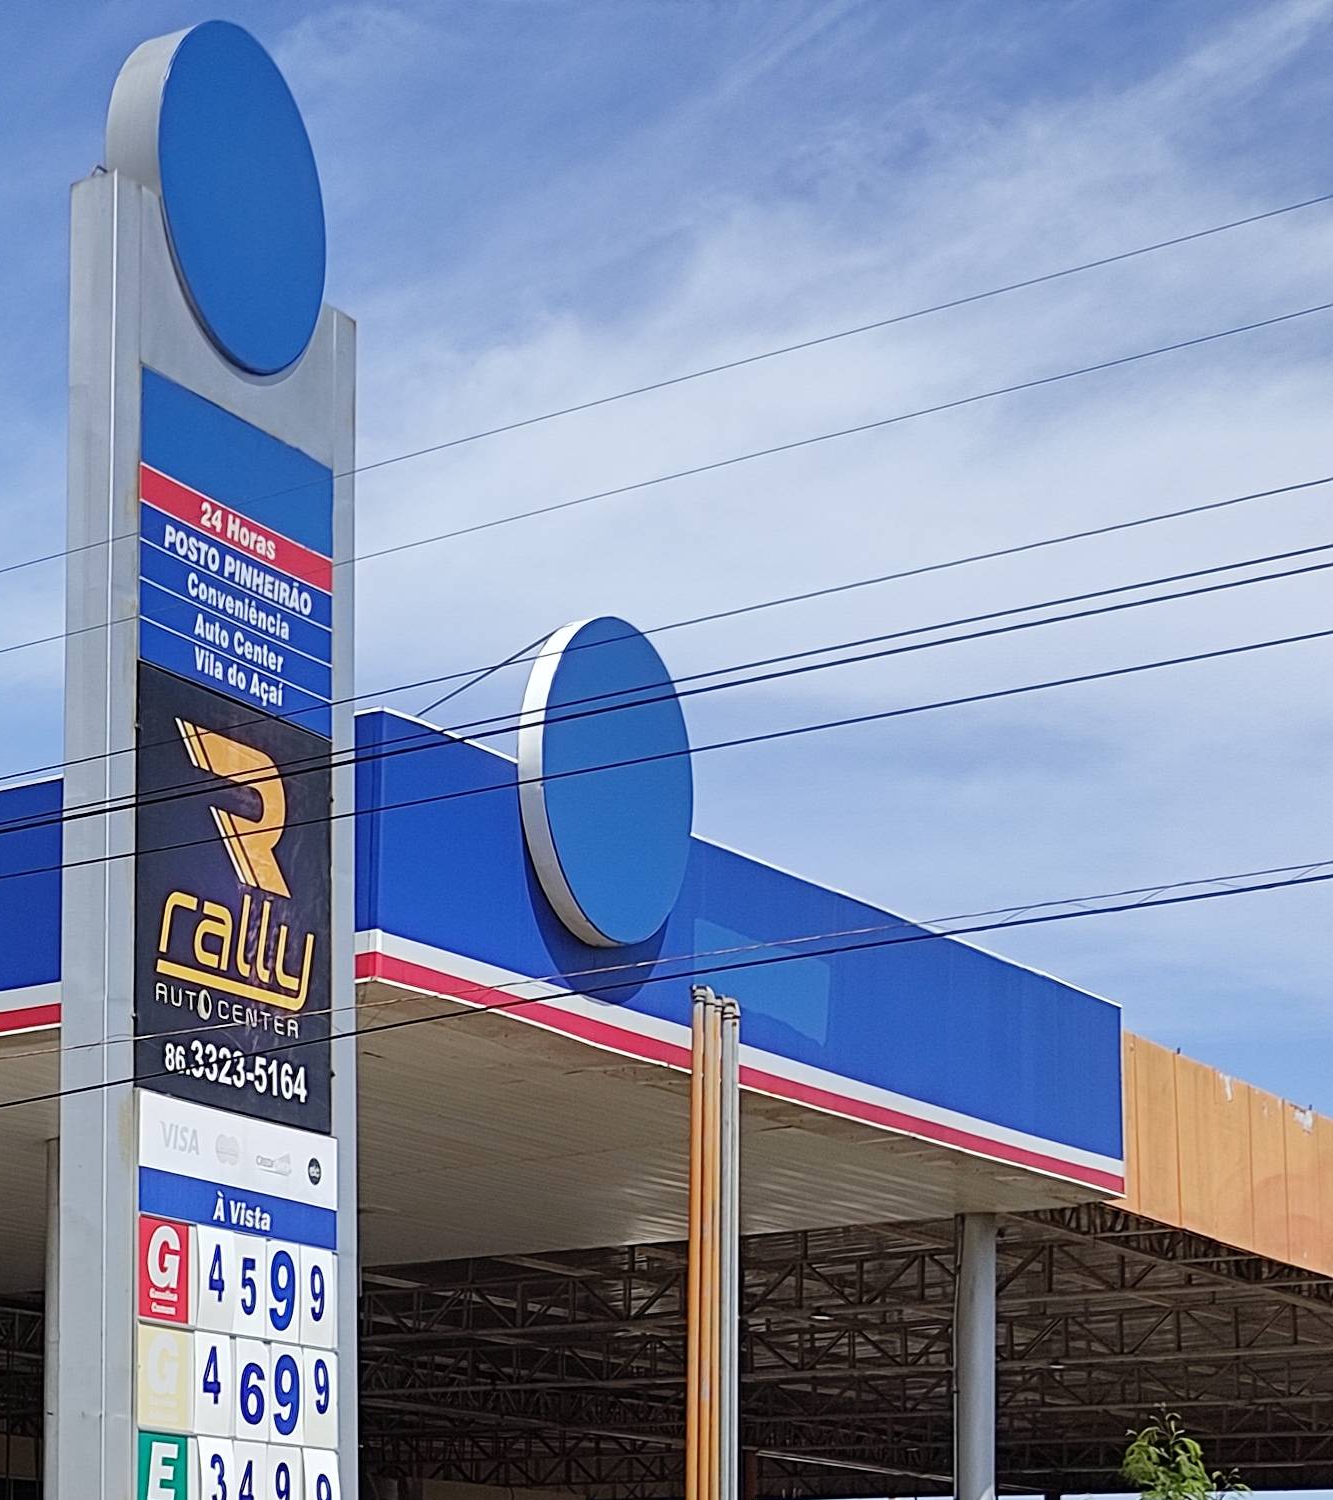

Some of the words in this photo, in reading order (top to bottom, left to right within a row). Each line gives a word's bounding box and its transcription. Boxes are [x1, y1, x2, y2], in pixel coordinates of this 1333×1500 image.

[200, 501, 223, 534] 24
[226, 513, 277, 561] Horas
[164, 524, 220, 572] POSTO
[223, 555, 313, 616] PINHEIRÃO
[187, 572, 290, 640] Conveniência
[194, 613, 229, 649] Auto
[233, 631, 284, 673] Center
[194, 646, 223, 681] Vila
[227, 663, 247, 690] do
[249, 672, 284, 707] Açaí
[156, 891, 316, 1011] rally
[155, 981, 213, 1021] AUTO
[217, 999, 300, 1039] CENTER
[159, 1120, 200, 1156] VISA
[212, 1190, 226, 1222] À
[229, 1200, 272, 1232] Vista
[147, 1225, 181, 1289] G
